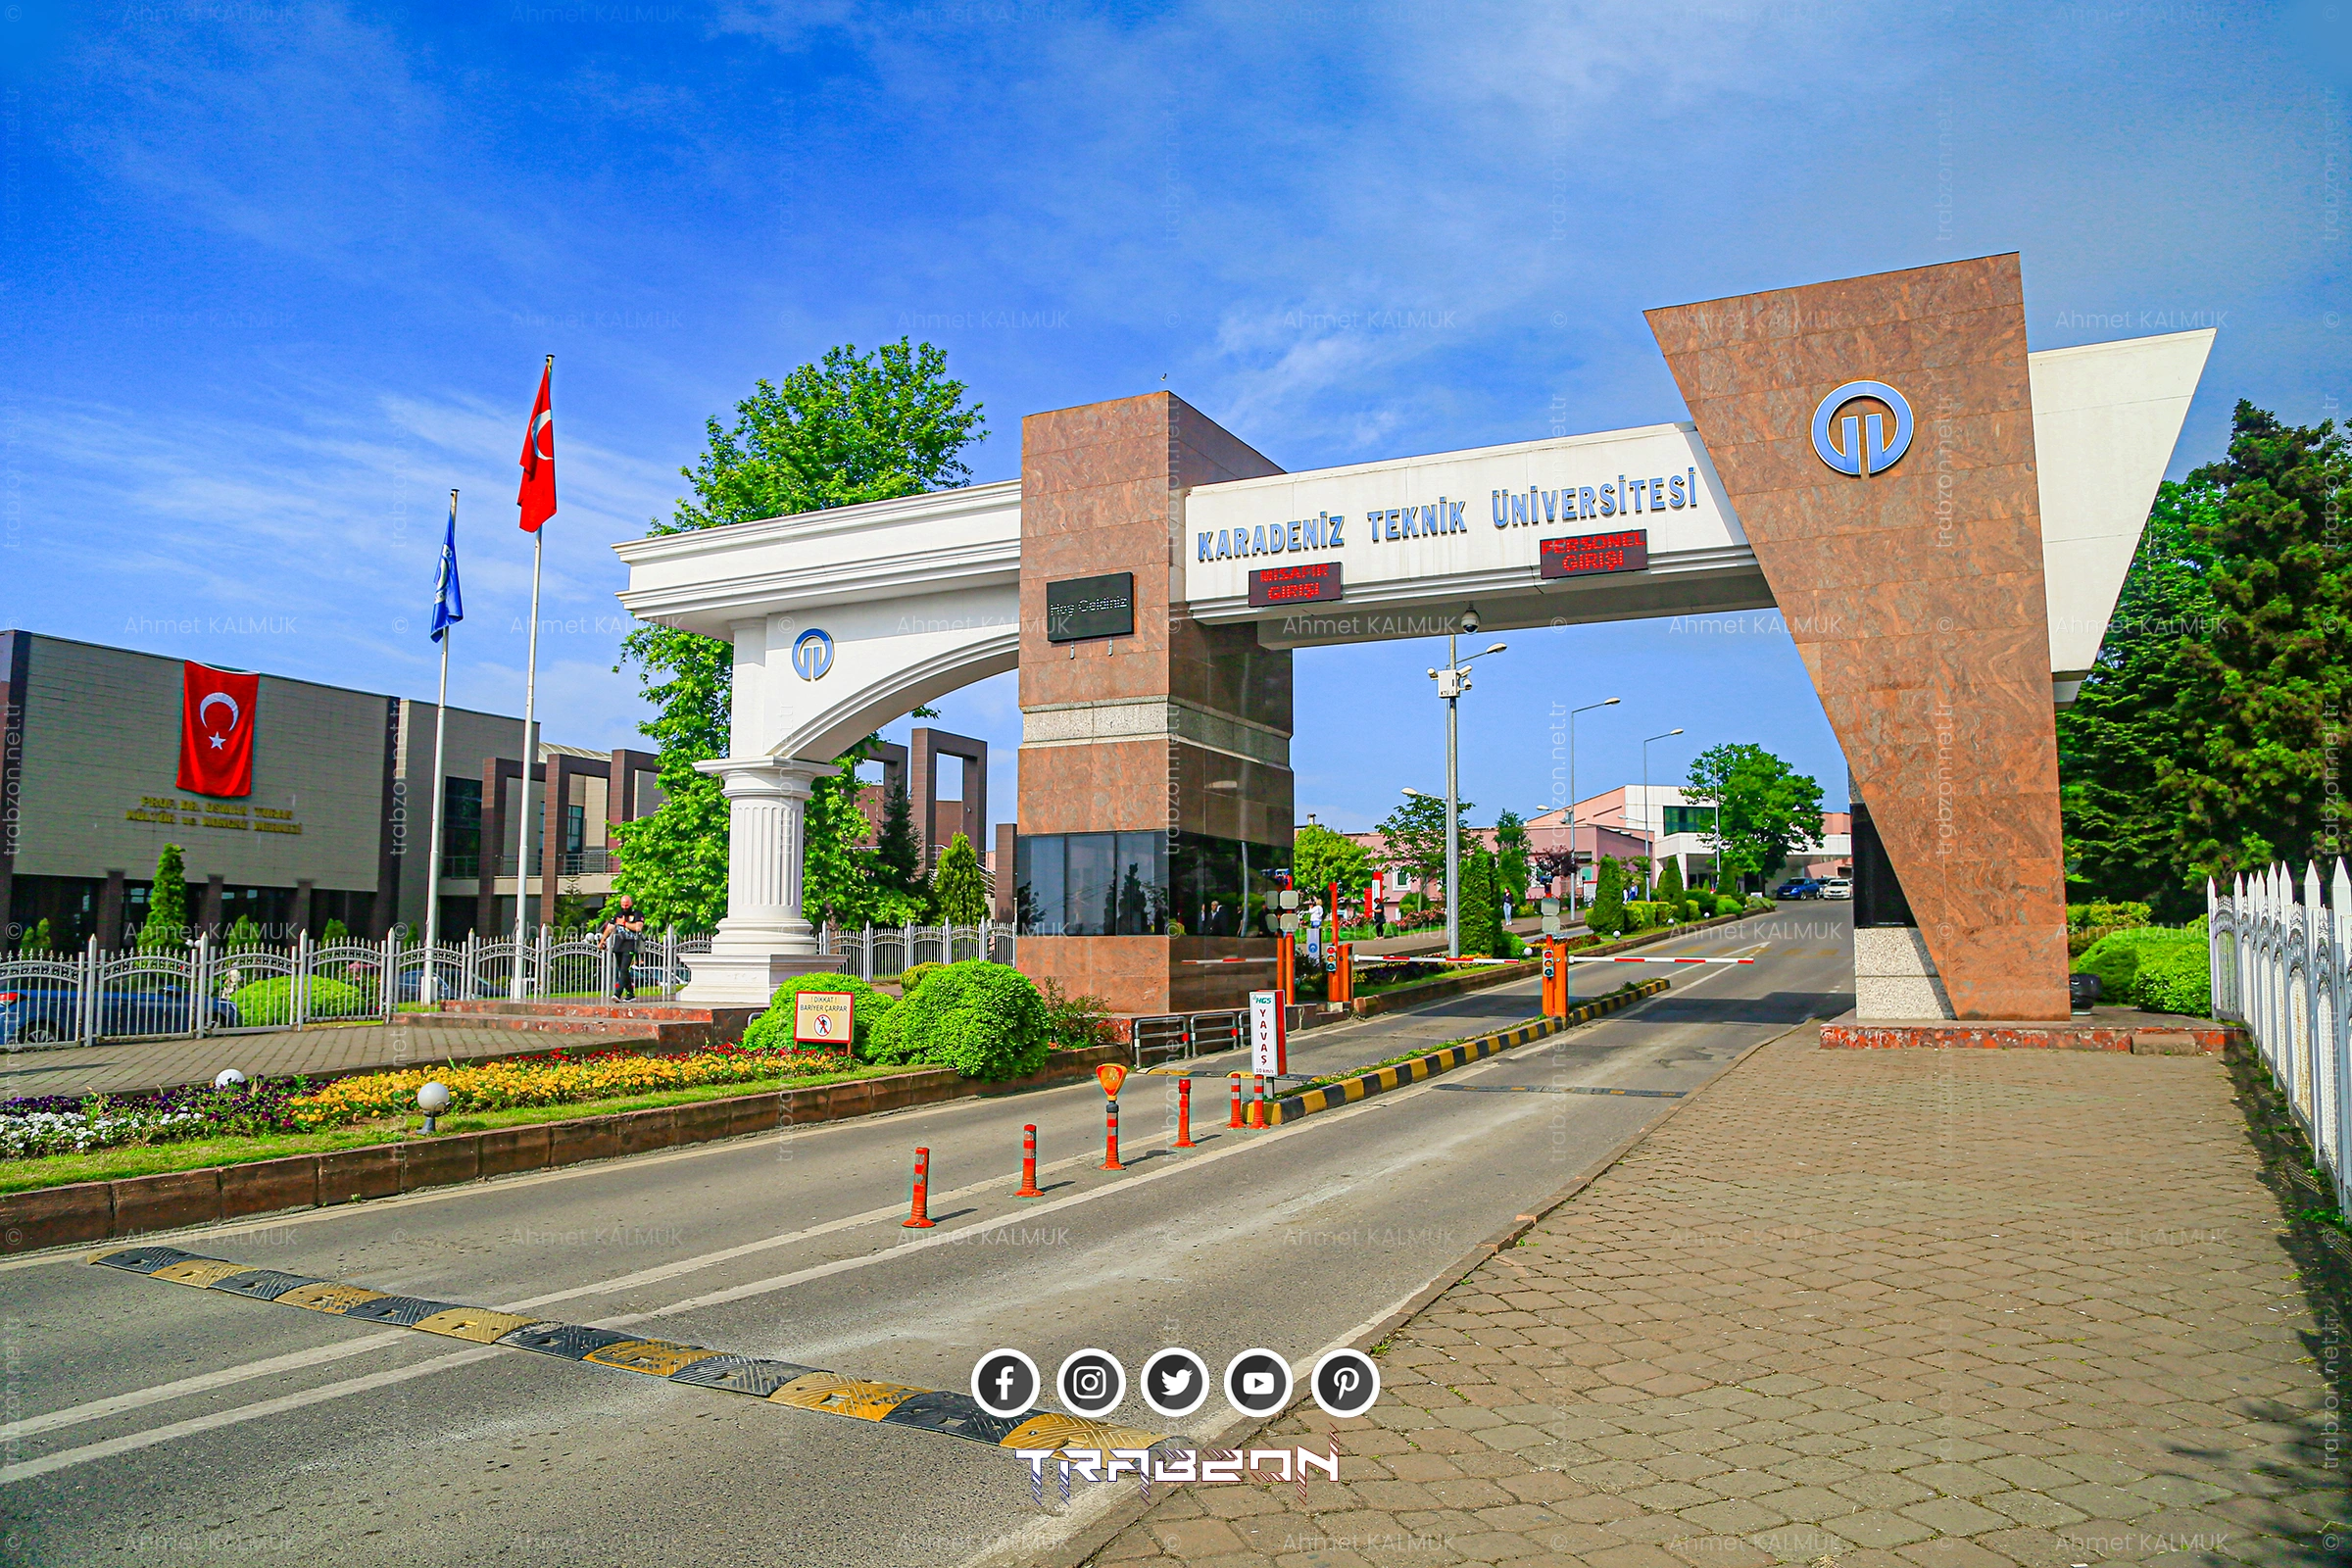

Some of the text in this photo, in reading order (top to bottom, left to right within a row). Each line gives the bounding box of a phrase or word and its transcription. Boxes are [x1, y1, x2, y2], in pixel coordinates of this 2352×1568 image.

[1198, 466, 1698, 563] KARADENİZ TEKNİK ÜNİVERSİTESİ
[1541, 531, 1646, 556] PERSONEL
[1259, 1008, 1268, 1065] YAVAŞ
